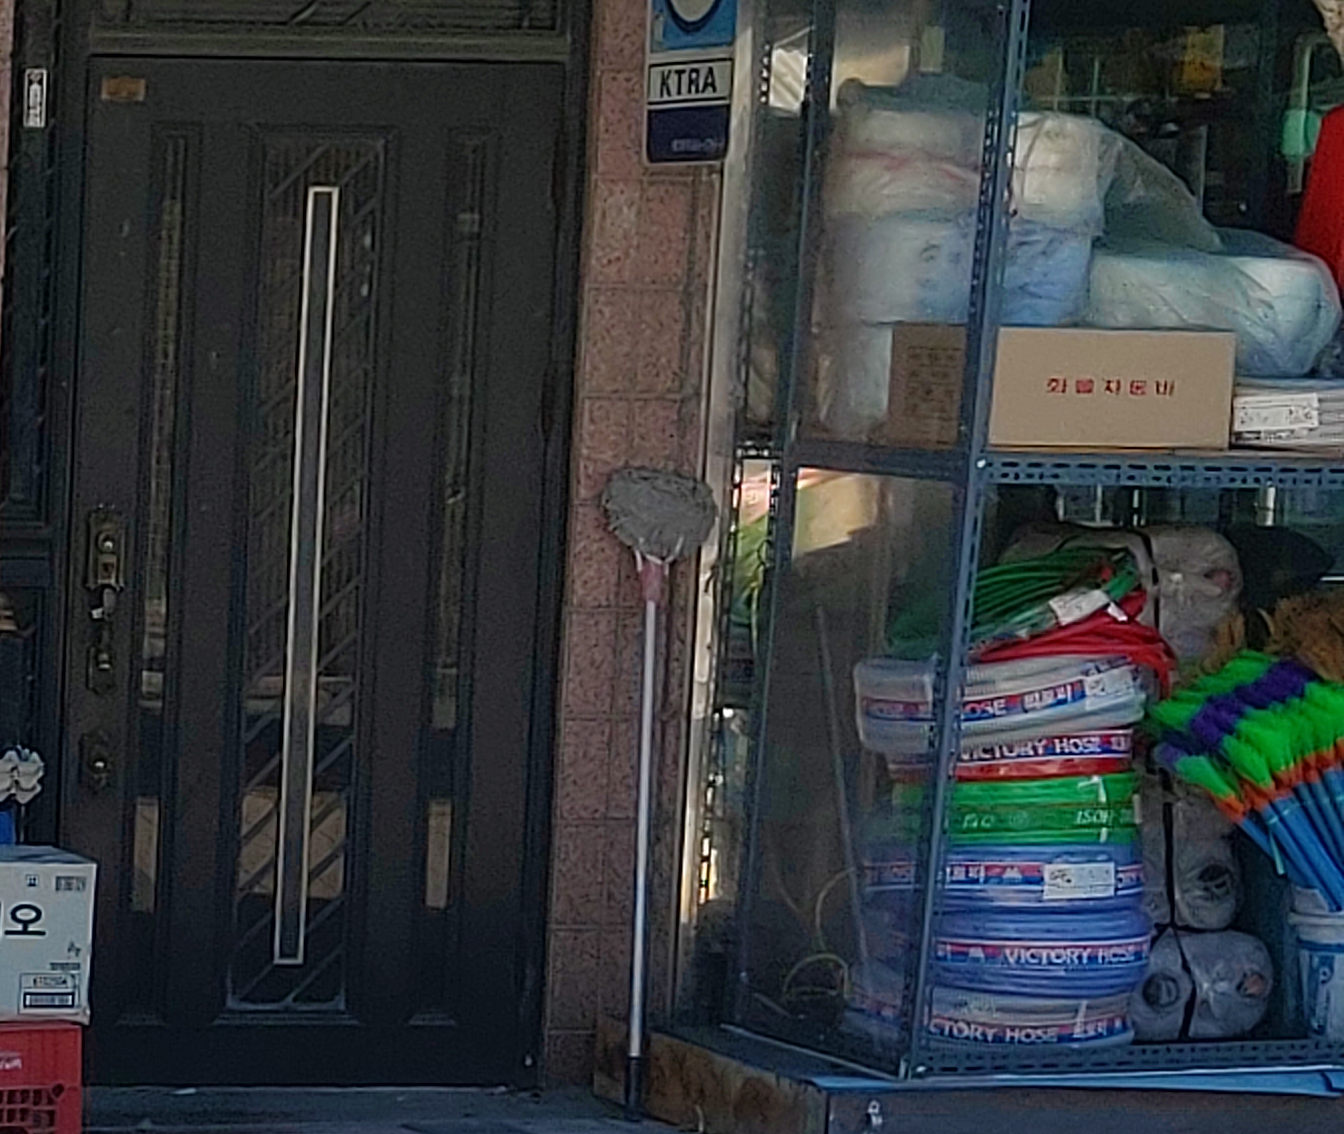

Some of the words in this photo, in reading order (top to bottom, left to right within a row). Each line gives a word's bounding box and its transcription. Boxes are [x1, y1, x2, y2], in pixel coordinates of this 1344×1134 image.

[659, 66, 718, 98] KTRA
[963, 698, 1007, 717] OSE
[1004, 947, 1092, 966] VICTORY
[928, 1018, 1002, 1043] CTORY
[1004, 1026, 1059, 1043] HOSE
